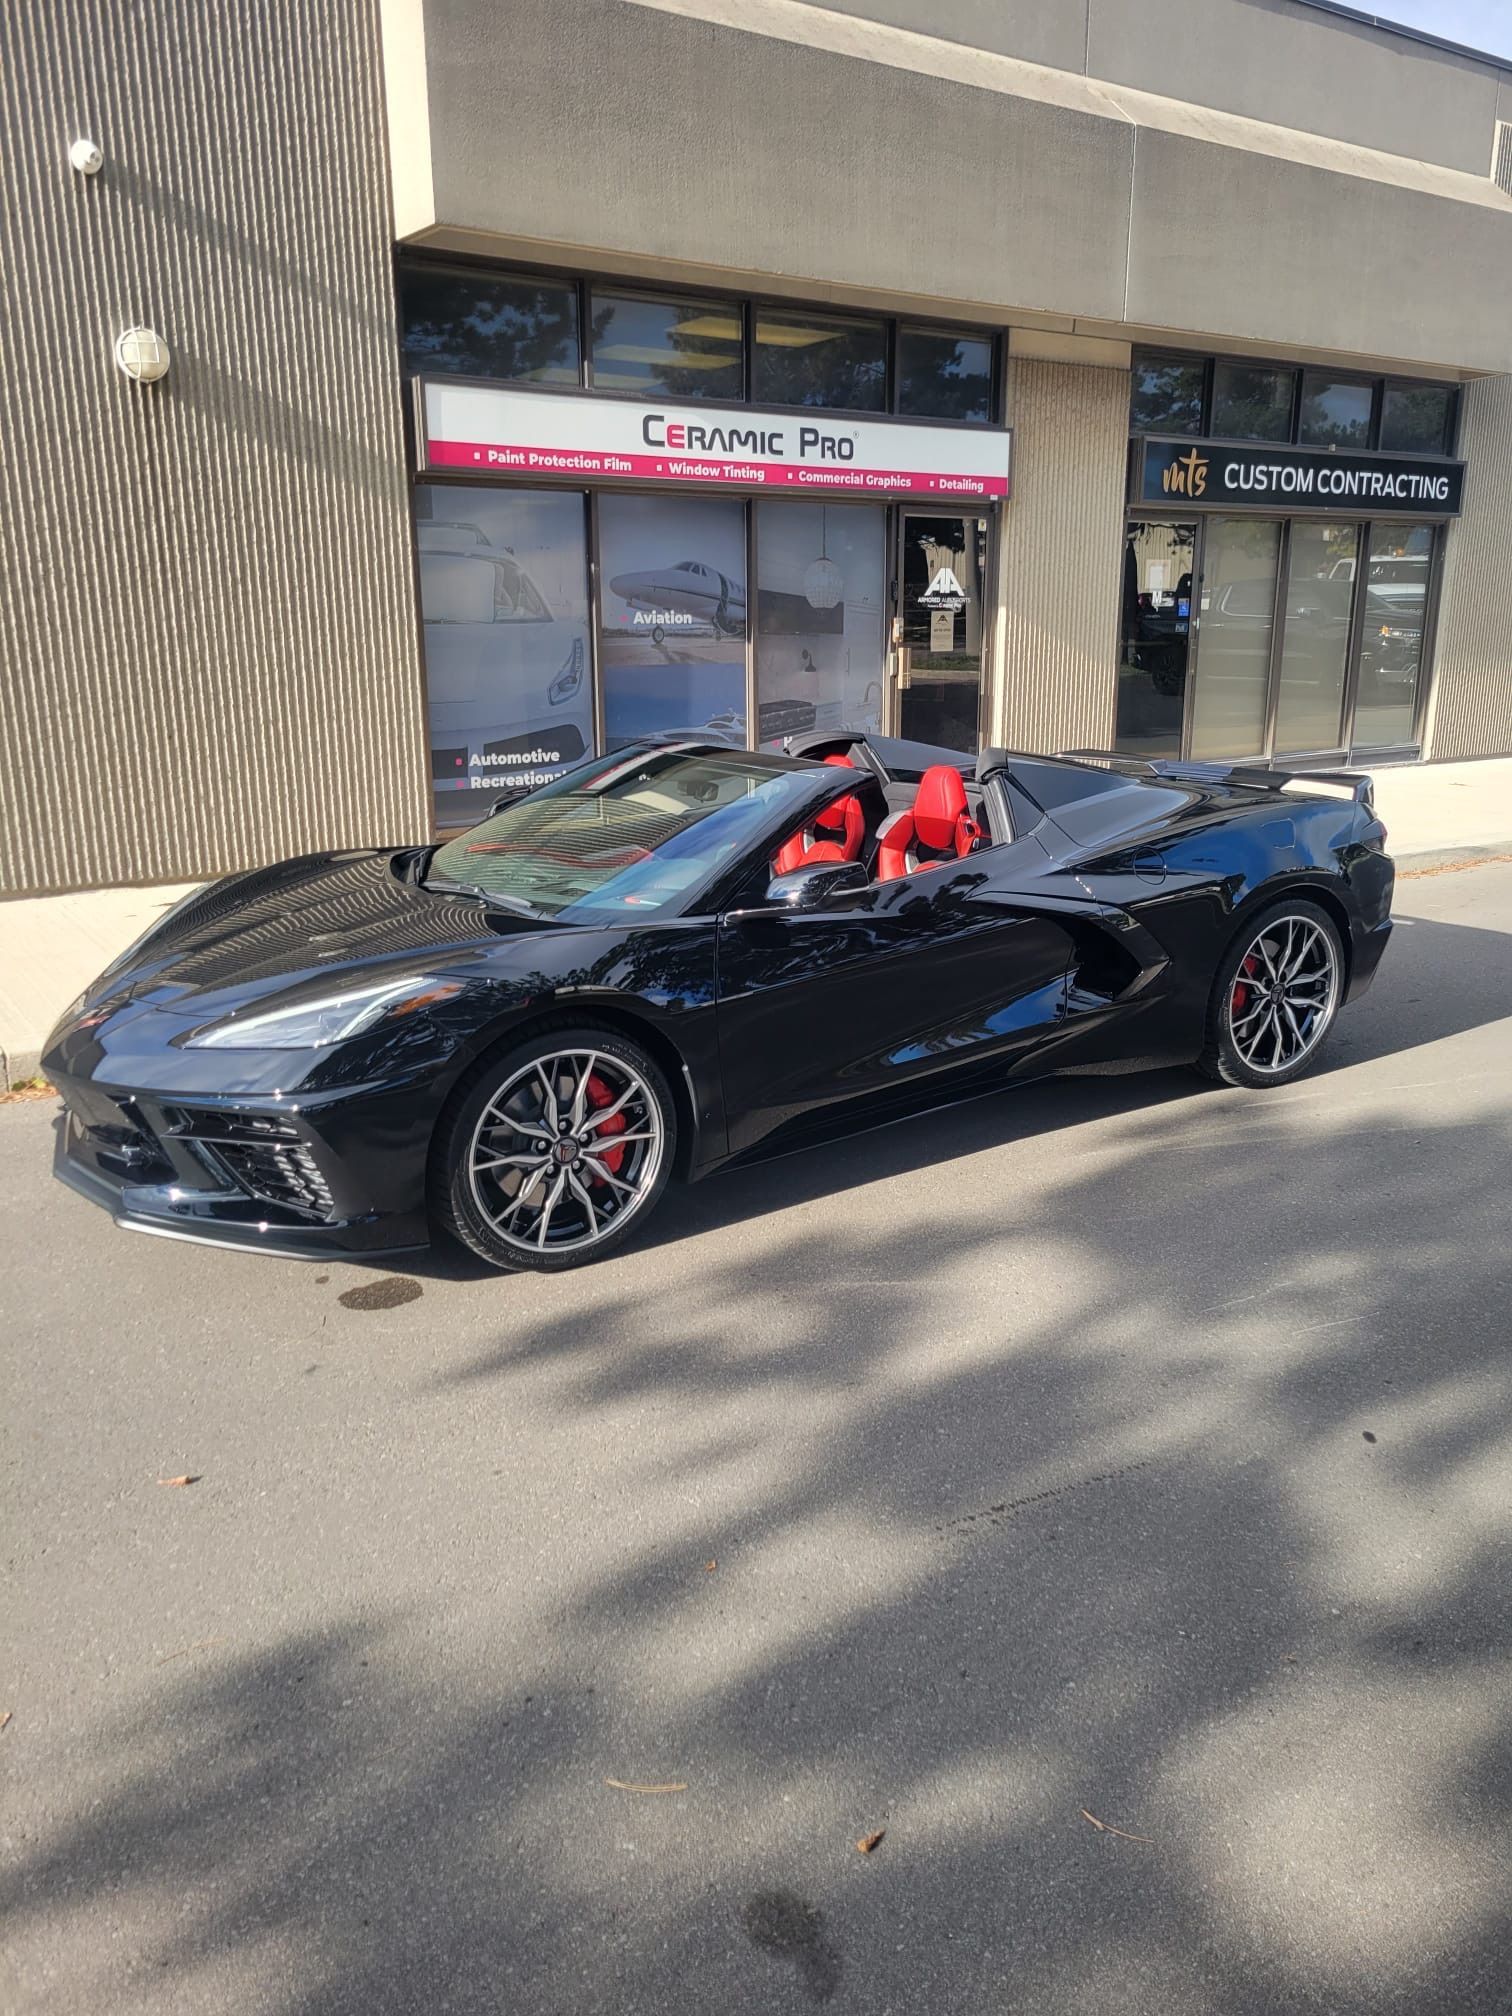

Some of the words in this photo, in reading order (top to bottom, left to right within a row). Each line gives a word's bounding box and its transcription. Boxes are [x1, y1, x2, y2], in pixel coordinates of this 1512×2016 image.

[643, 414, 783, 455] CERAMIC
[488, 450, 525, 465] Paint
[529, 453, 601, 470] Protection
[604, 457, 632, 471] Film
[669, 462, 720, 477] Window
[723, 465, 765, 482] Tinting
[799, 470, 863, 486] Commercial
[866, 473, 911, 489] Graphics
[1224, 463, 1314, 493] CUSTOM
[1317, 469, 1449, 500] CONTRACTING
[939, 478, 984, 493] Detailing
[633, 610, 693, 625] Aviation
[469, 748, 560, 767] Automotive
[470, 770, 567, 790] Recreation
